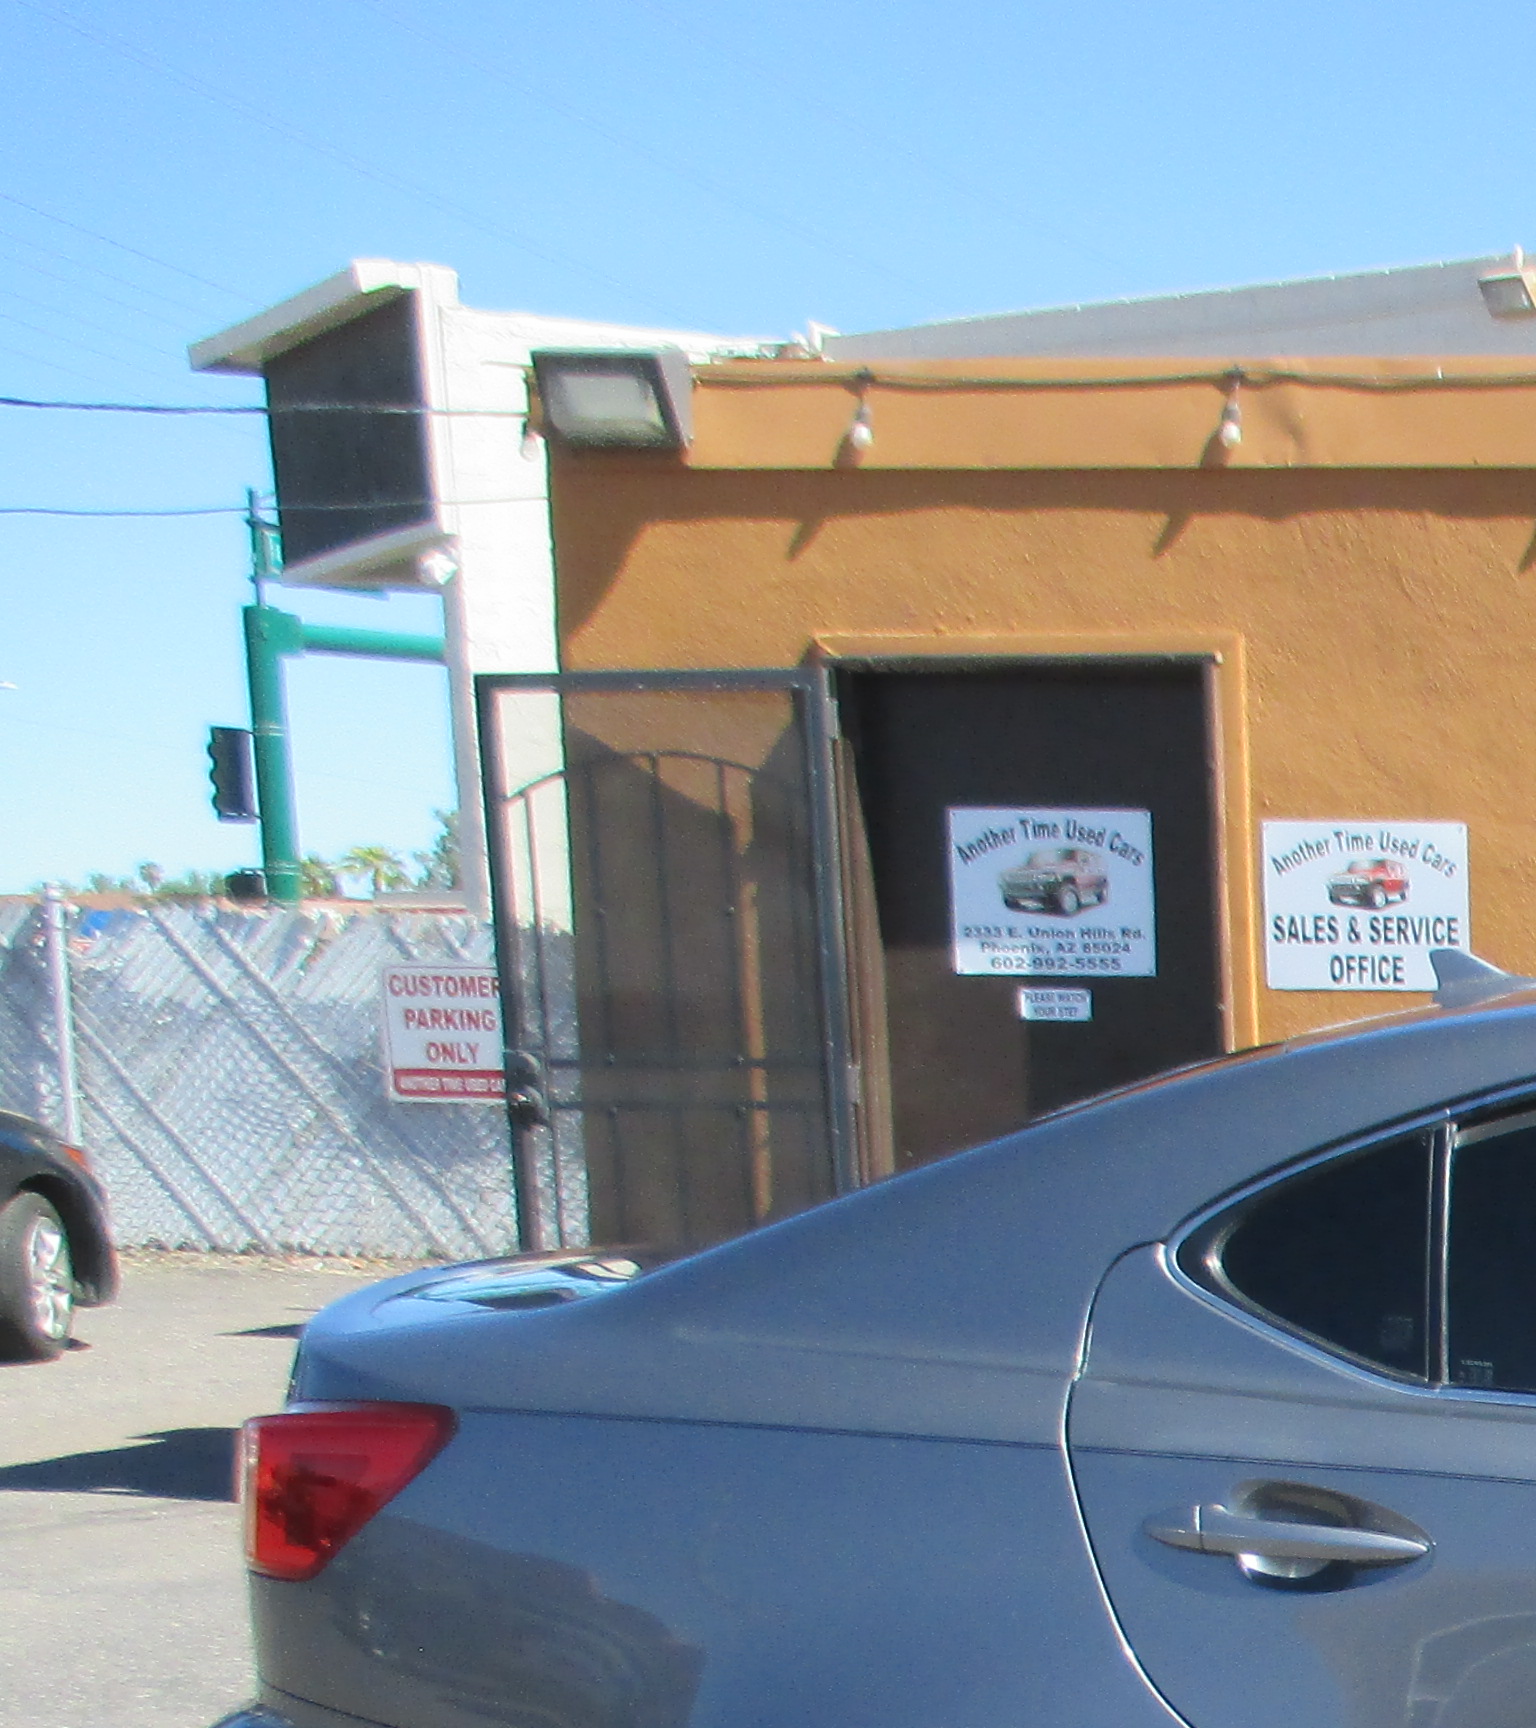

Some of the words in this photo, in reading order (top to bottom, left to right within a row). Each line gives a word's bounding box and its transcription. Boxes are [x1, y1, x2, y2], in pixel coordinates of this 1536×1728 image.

[955, 827, 1017, 866] Another
[1018, 817, 1061, 840] Time
[1066, 819, 1106, 847] Used
[1109, 831, 1146, 866] Cars
[1271, 838, 1331, 877] Another
[1333, 830, 1374, 852] Time
[1379, 830, 1419, 858] Used
[1421, 843, 1457, 878] Cars
[1028, 926, 1076, 938] Union
[1273, 914, 1340, 944] SALES
[1347, 916, 1361, 944] &
[1369, 916, 1460, 945] SERVICE
[1056, 942, 1077, 954] AZ
[990, 957, 1122, 970] 602-992-5555
[1330, 955, 1405, 984] OFFICE
[389, 974, 500, 998] CUSTOMER
[404, 1008, 498, 1032] PARKING
[426, 1041, 480, 1064] ONLY
